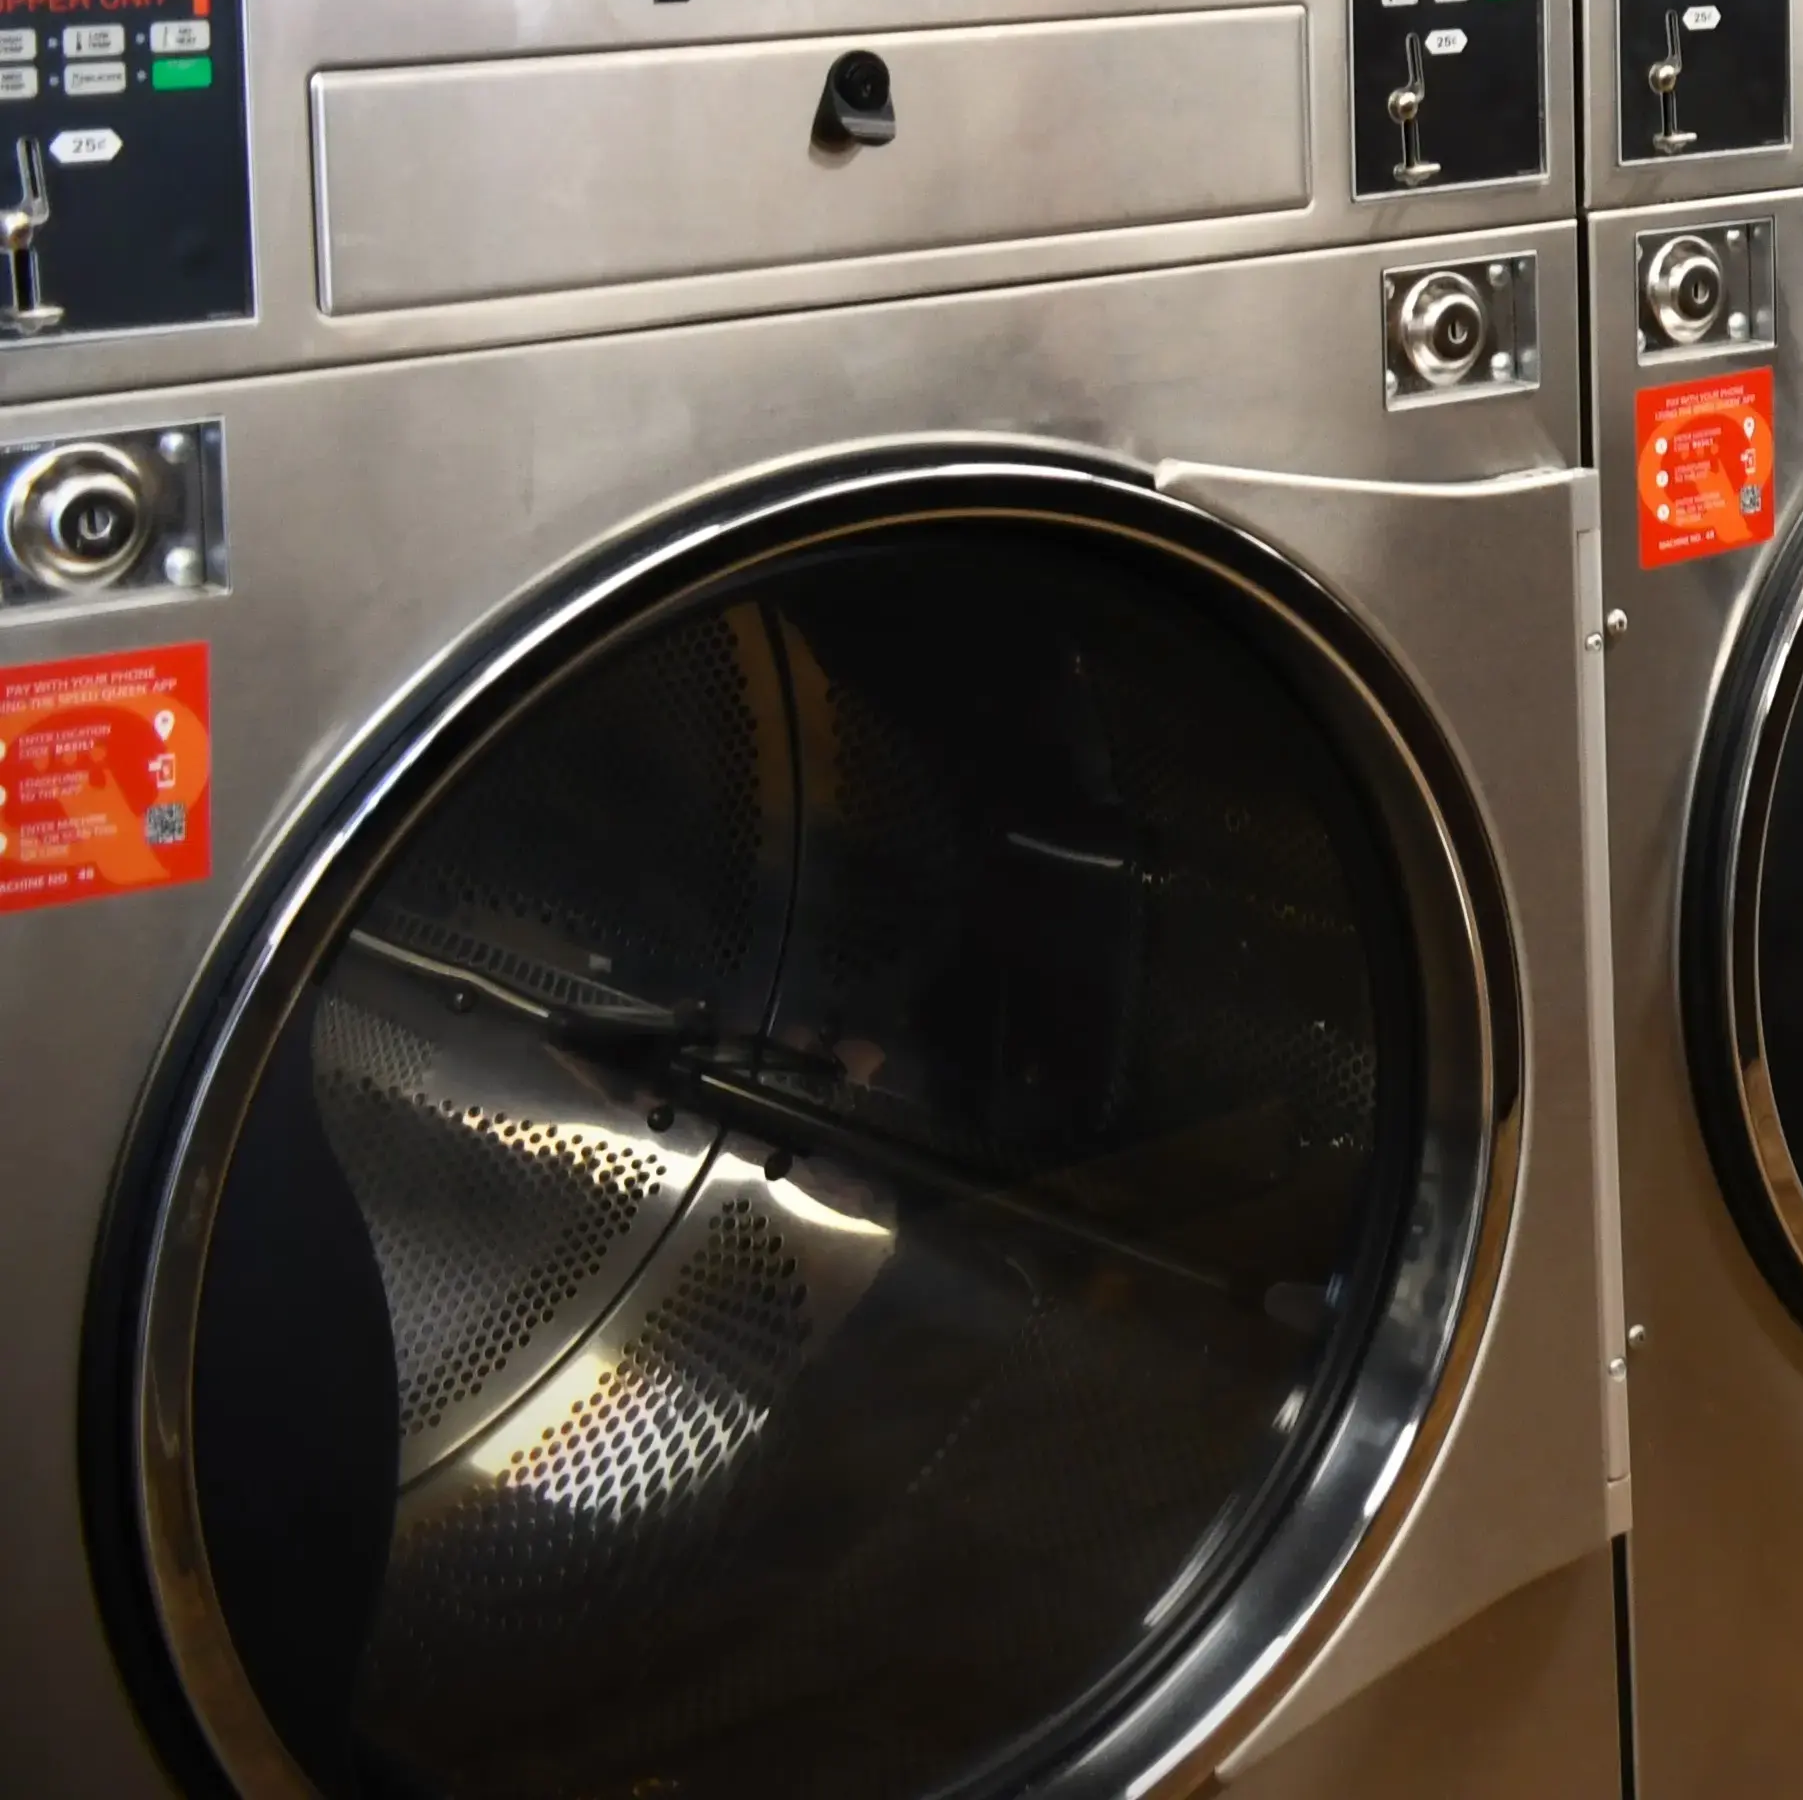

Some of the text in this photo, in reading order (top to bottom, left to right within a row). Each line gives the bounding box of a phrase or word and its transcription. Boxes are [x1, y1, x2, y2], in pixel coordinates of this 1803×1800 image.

[6, 665, 155, 698] PAY WITH YOUR PHONE
[153, 676, 178, 693] APP
[0, 874, 45, 894] ACHINE
